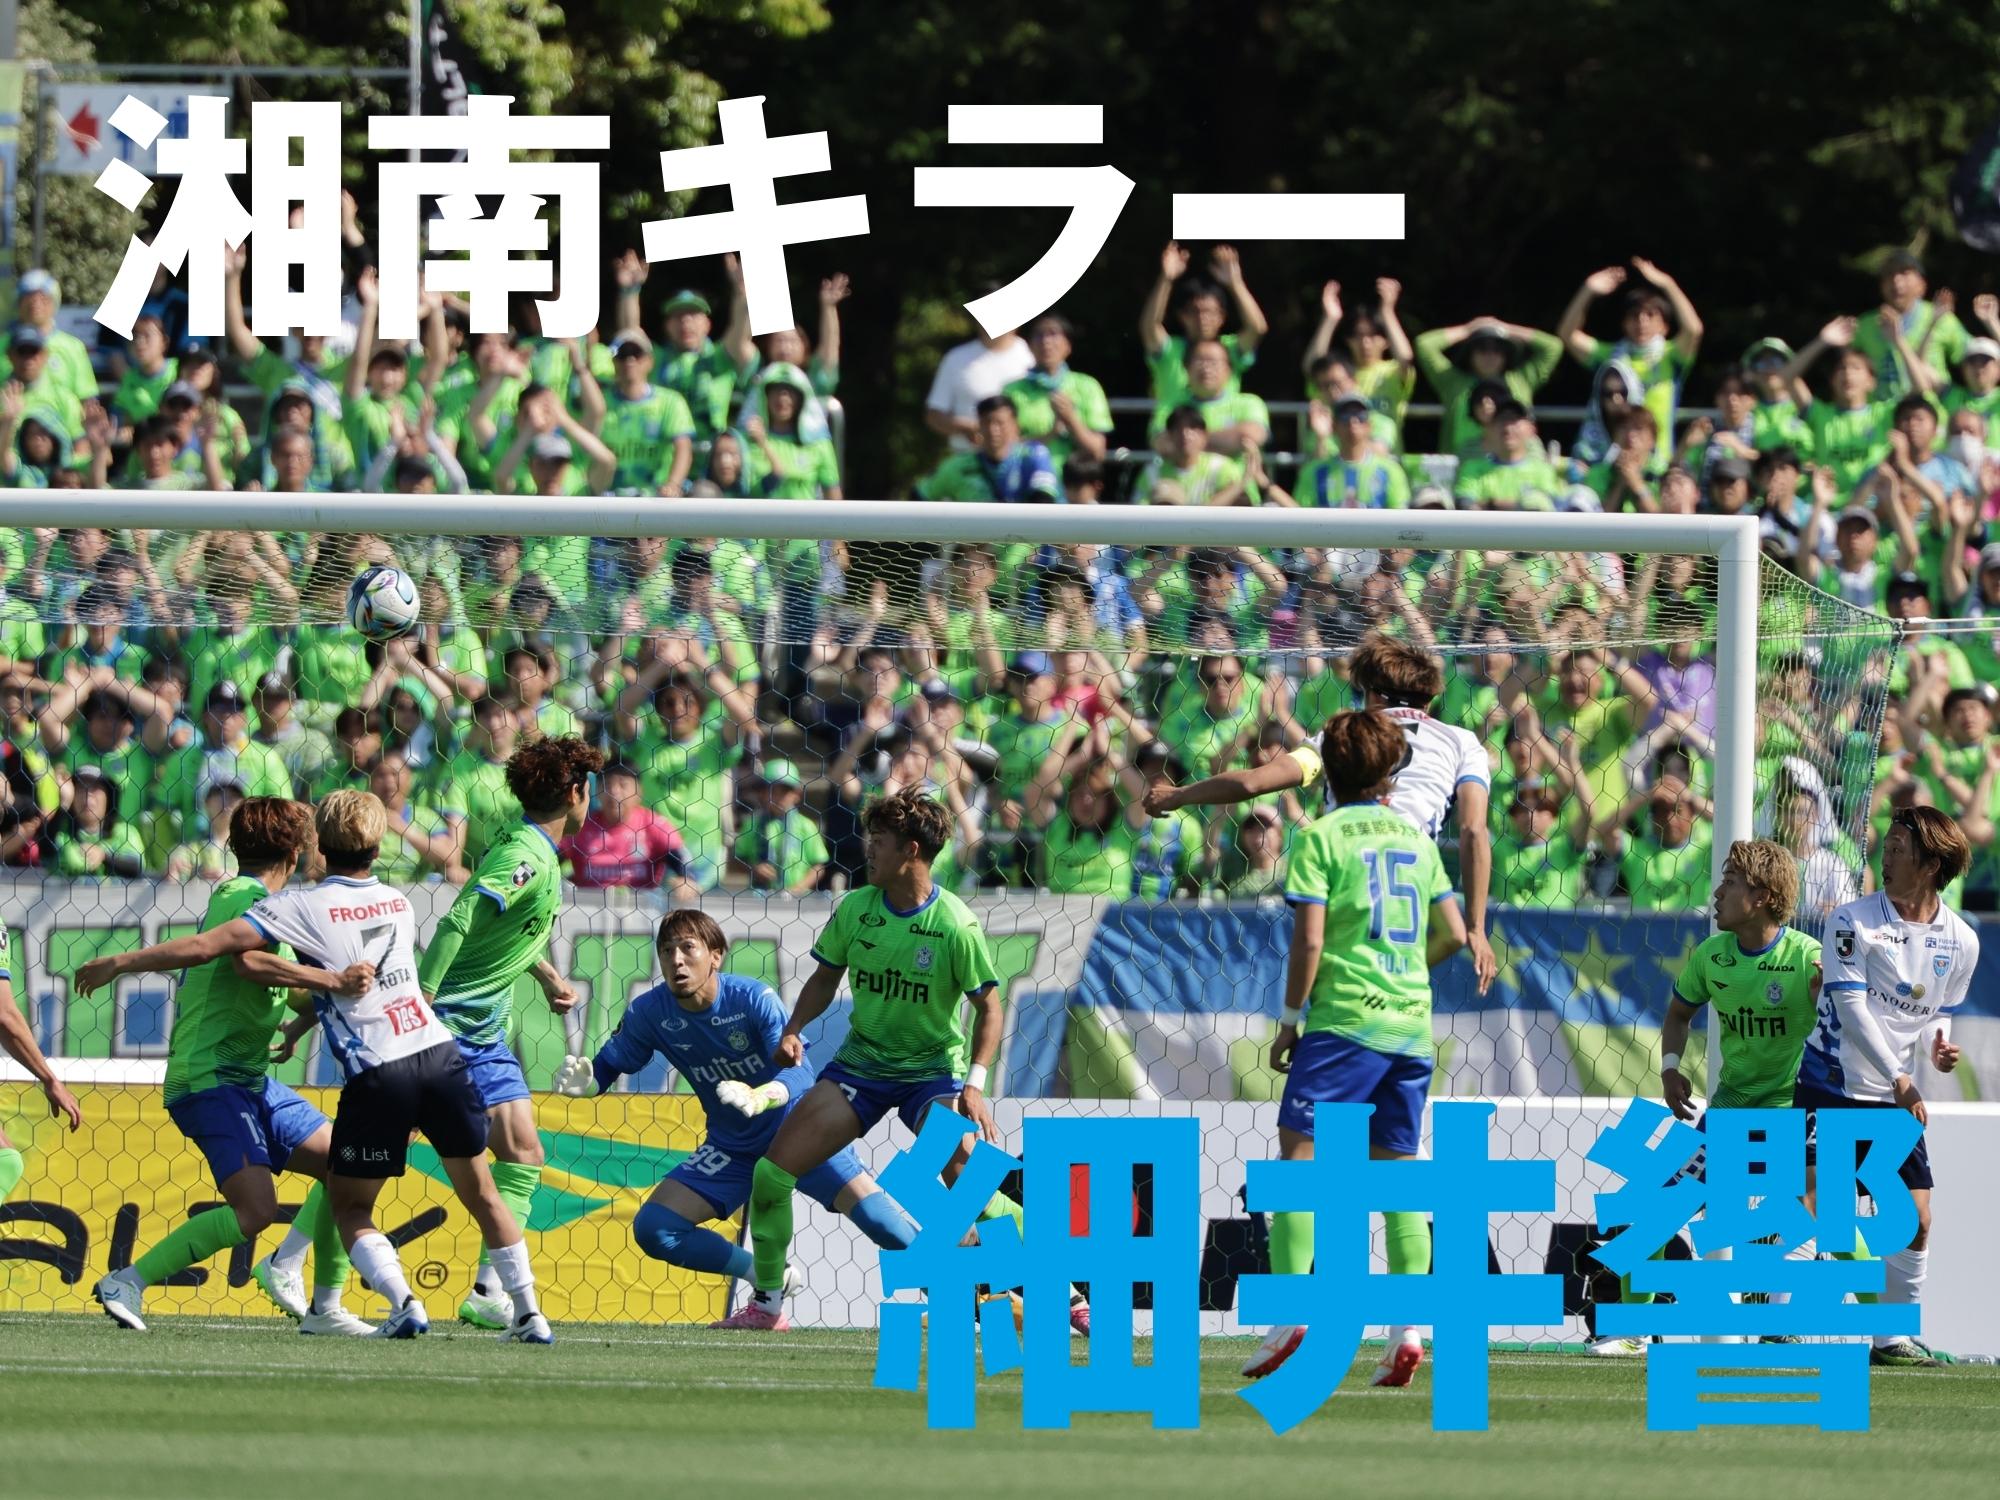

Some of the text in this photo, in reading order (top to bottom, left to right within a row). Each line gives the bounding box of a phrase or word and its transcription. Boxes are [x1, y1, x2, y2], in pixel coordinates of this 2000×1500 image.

[328, 897, 410, 924] FRONTIER
[1362, 849, 1420, 945] 15
[360, 921, 398, 980] 7
[856, 968, 929, 1005] FUJITA
[1867, 986, 1936, 1016] ONODER
[689, 1053, 766, 1084] FUJITA
[363, 1146, 391, 1161] List
